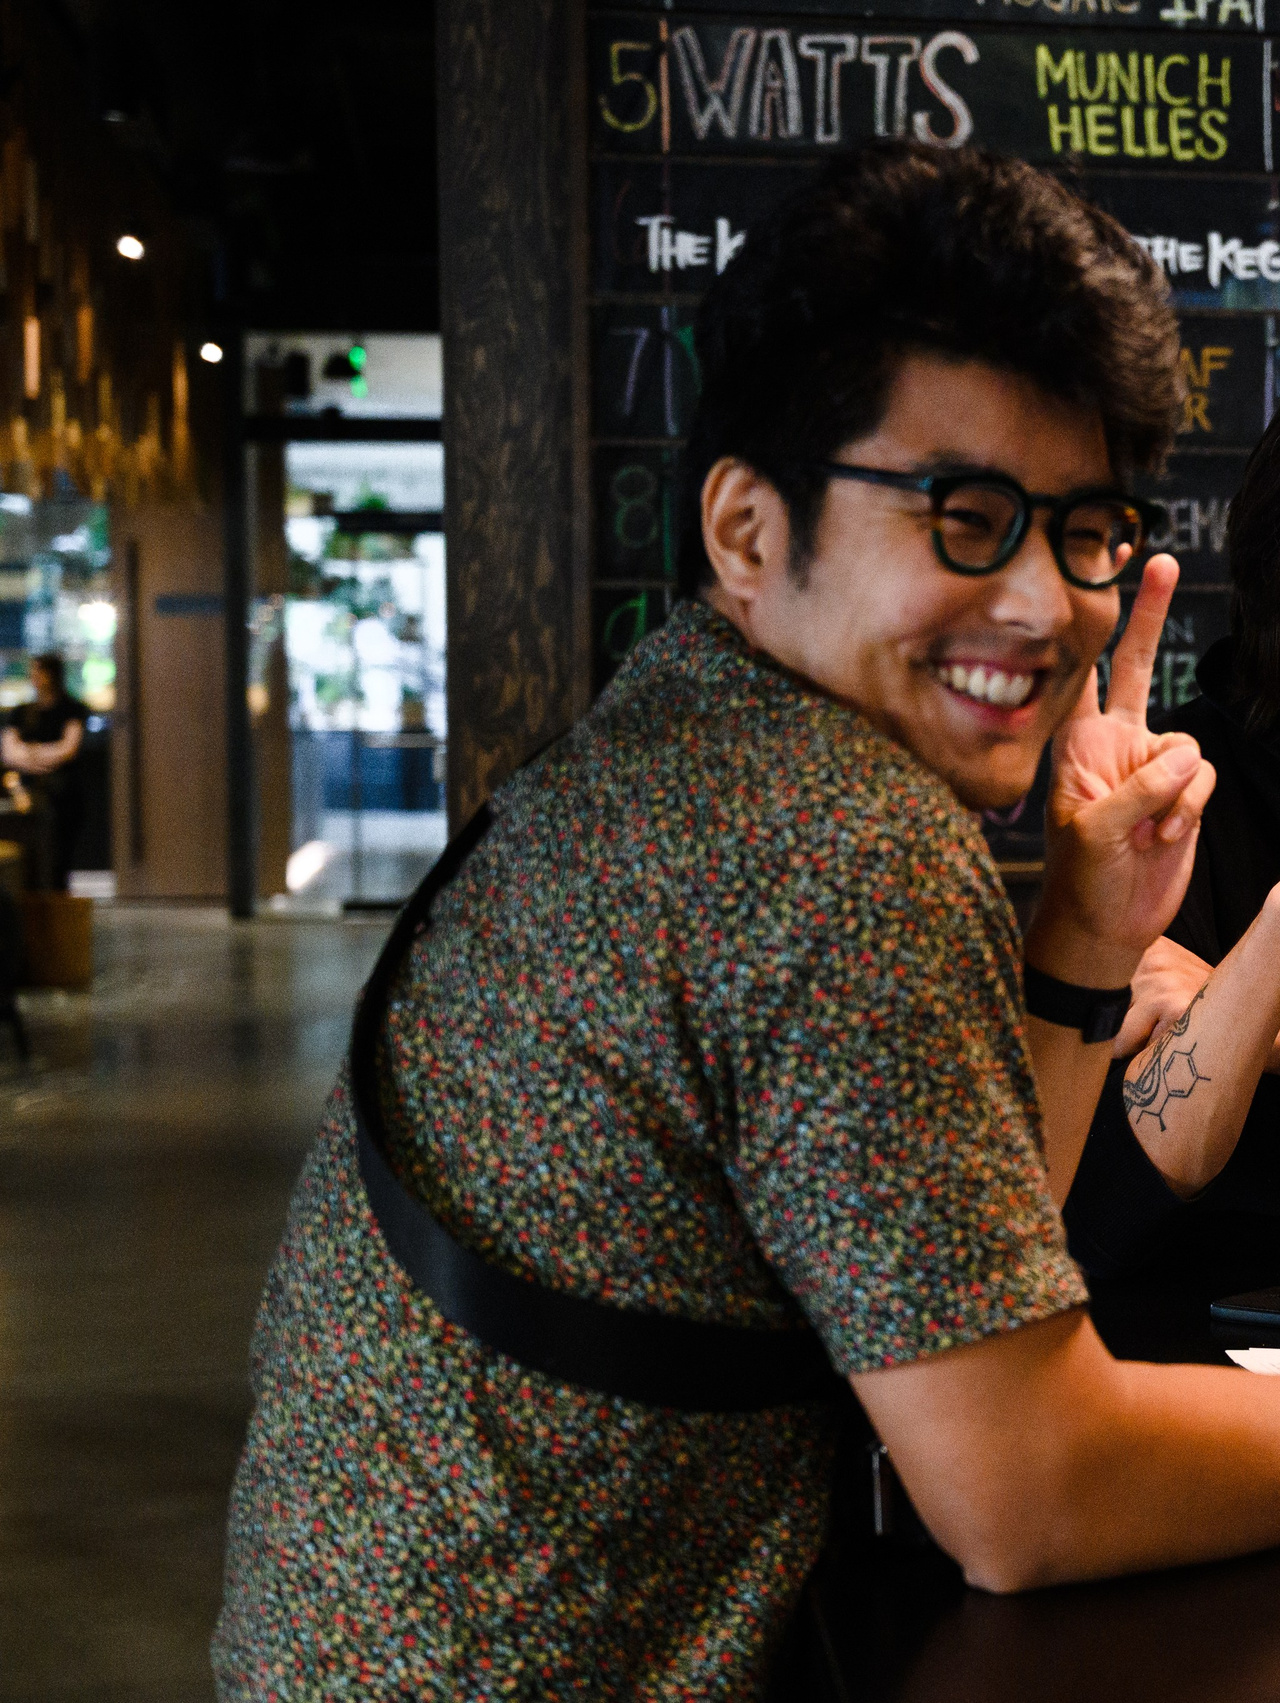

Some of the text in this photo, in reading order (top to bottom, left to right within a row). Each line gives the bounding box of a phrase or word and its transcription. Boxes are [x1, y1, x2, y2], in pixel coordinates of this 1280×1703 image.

[599, 25, 981, 149] 5 WATTS
[1036, 43, 1232, 107] MUNICH
[1048, 103, 1228, 162] HELLES
